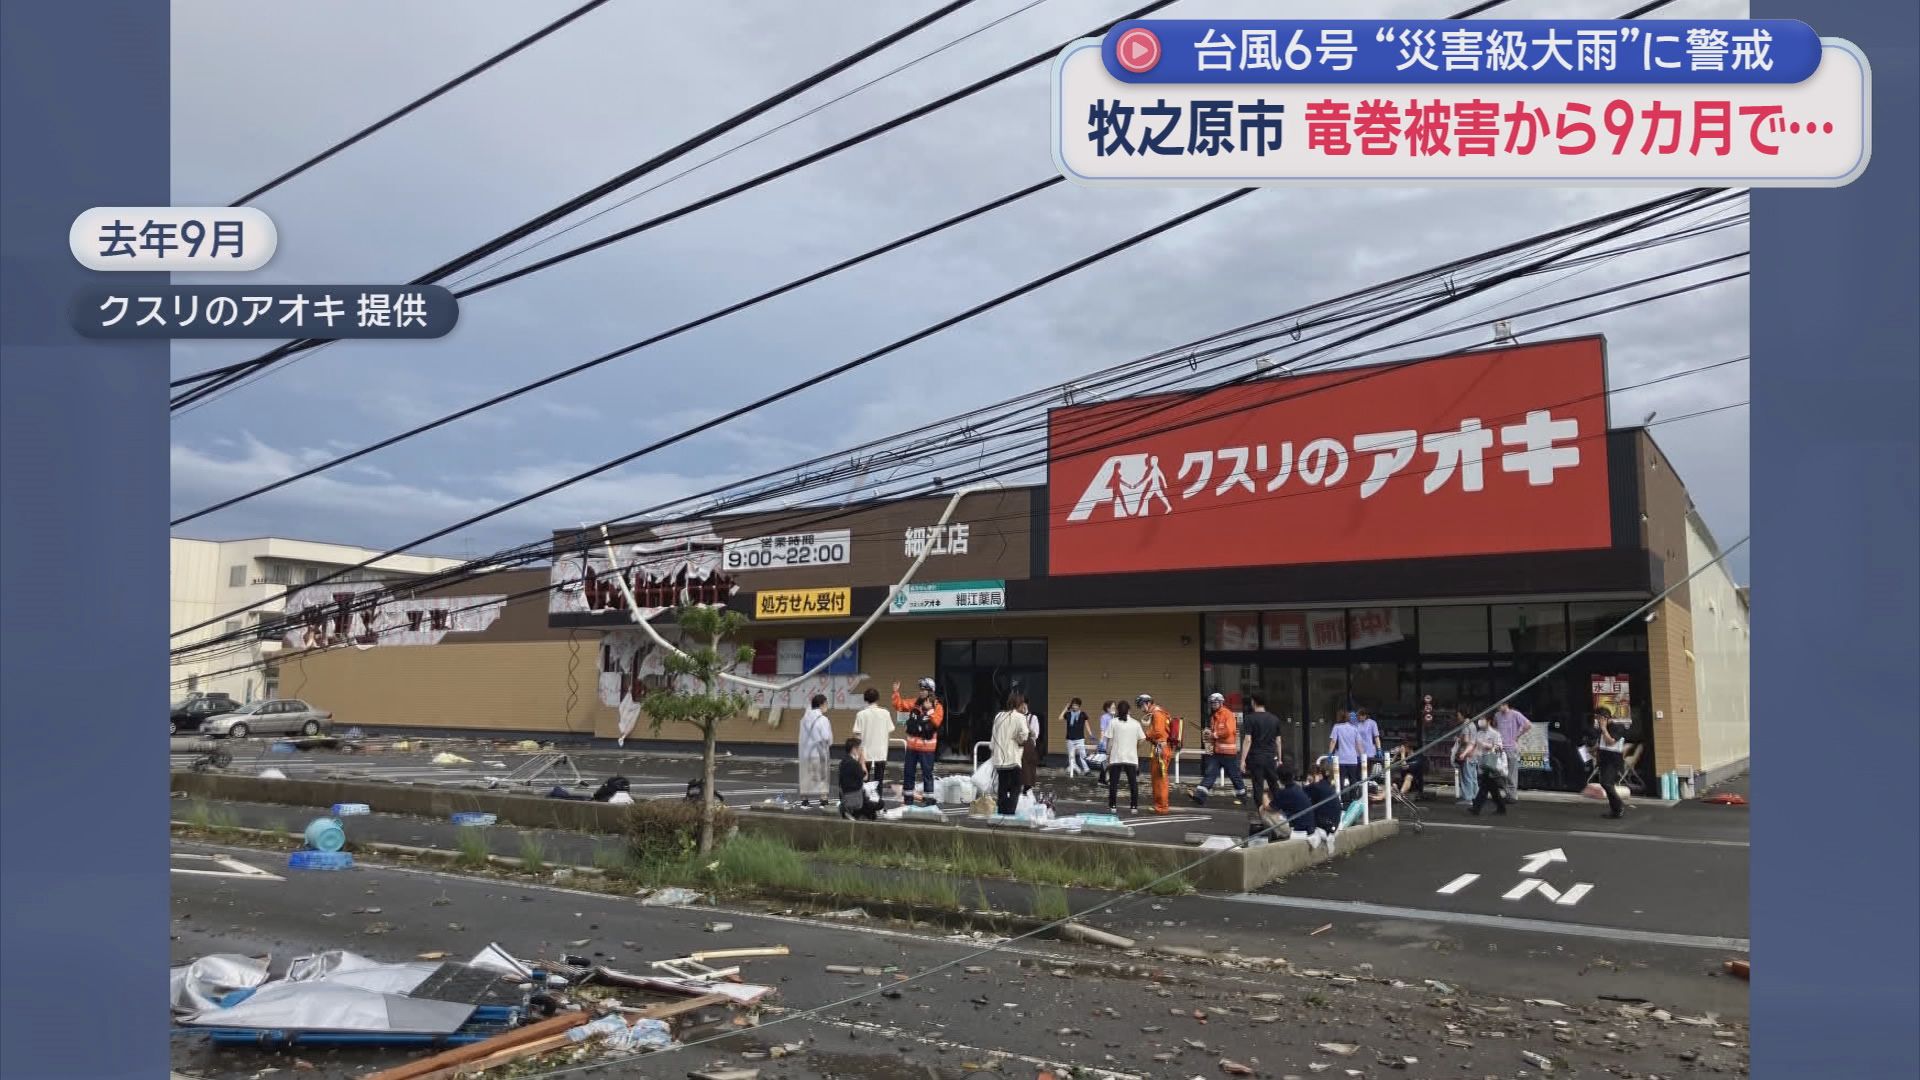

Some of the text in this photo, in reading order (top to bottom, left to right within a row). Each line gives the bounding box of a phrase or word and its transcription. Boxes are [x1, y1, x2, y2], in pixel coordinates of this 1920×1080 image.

[1177, 409, 1580, 499] クスリのアオキ
[761, 535, 815, 548] 営業時間
[905, 523, 969, 557] 細江店
[761, 592, 845, 613] 処方せん受付
[956, 591, 1002, 607] 細江薬局
[1223, 617, 1301, 650] SALE
